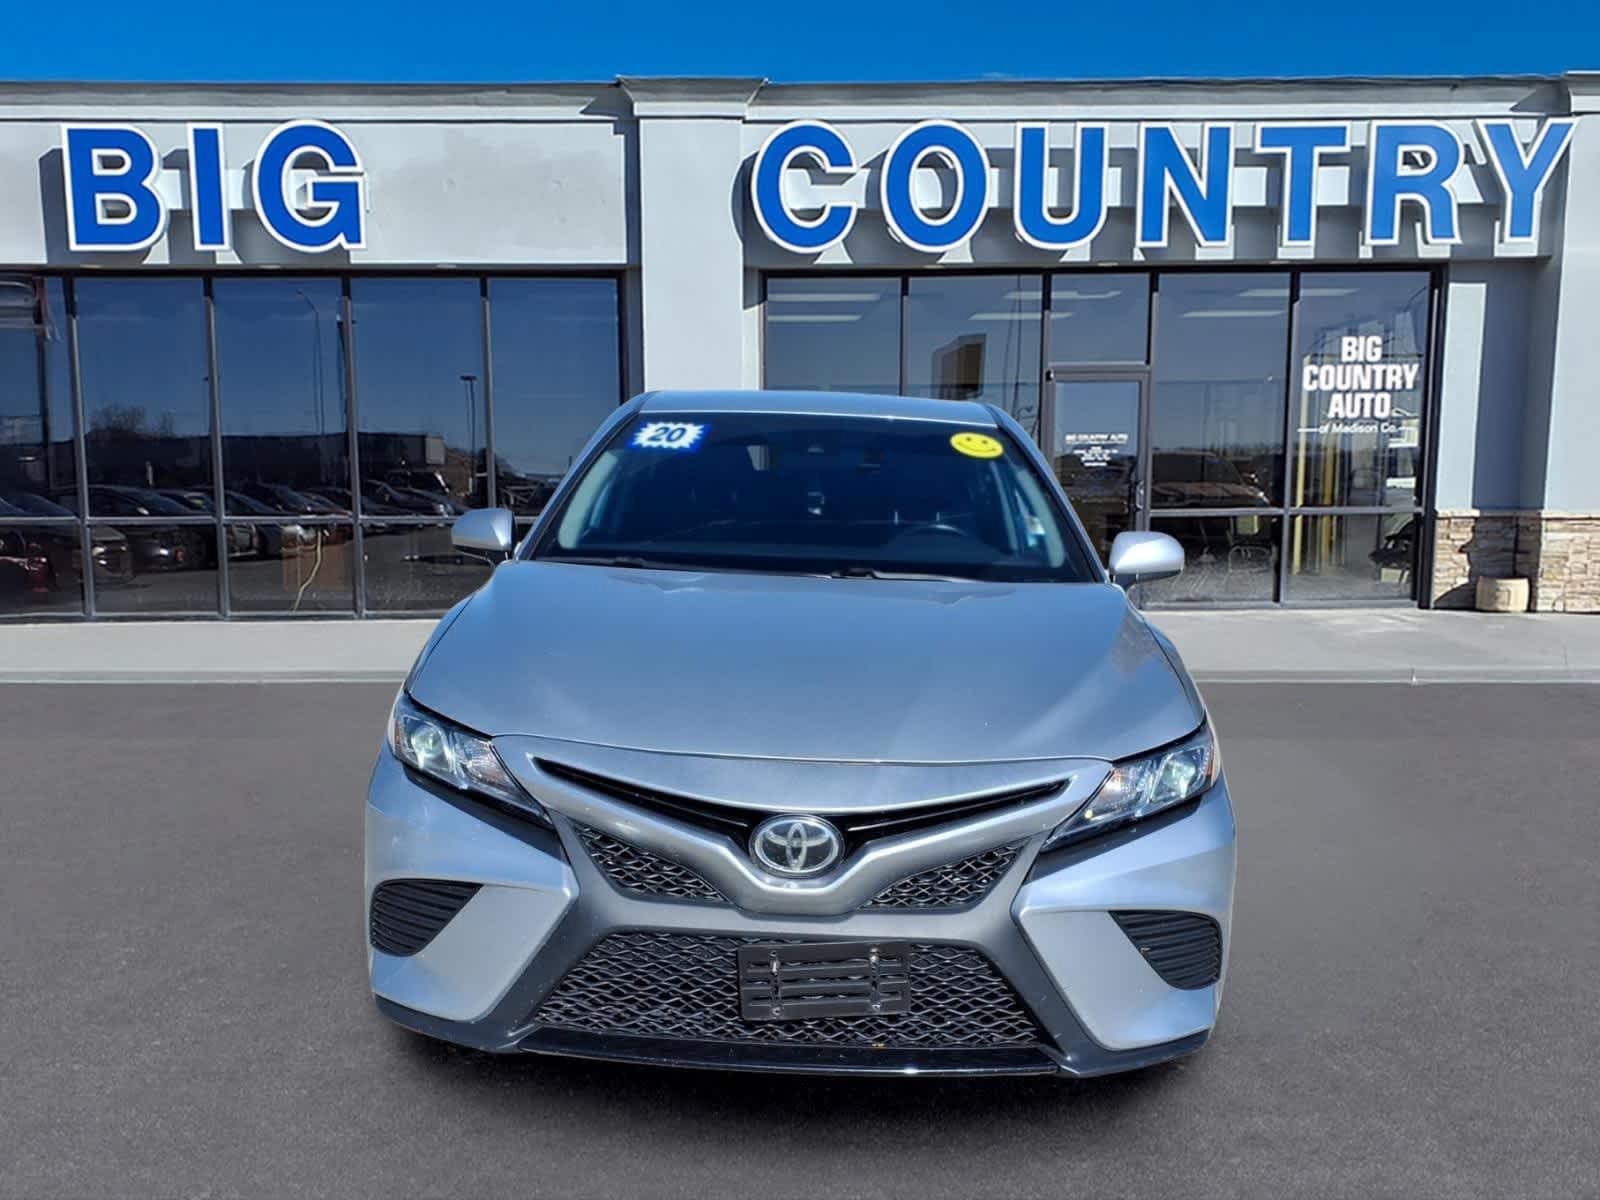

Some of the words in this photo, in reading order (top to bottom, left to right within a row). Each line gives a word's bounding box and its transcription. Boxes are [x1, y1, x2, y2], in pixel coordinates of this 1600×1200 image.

[61, 119, 366, 252] BIG
[751, 117, 1576, 254] COUNTRY
[1341, 336, 1382, 362] BIG
[1303, 364, 1419, 391] COUNTRY
[1328, 393, 1391, 419] AUTO
[647, 426, 687, 442] 20
